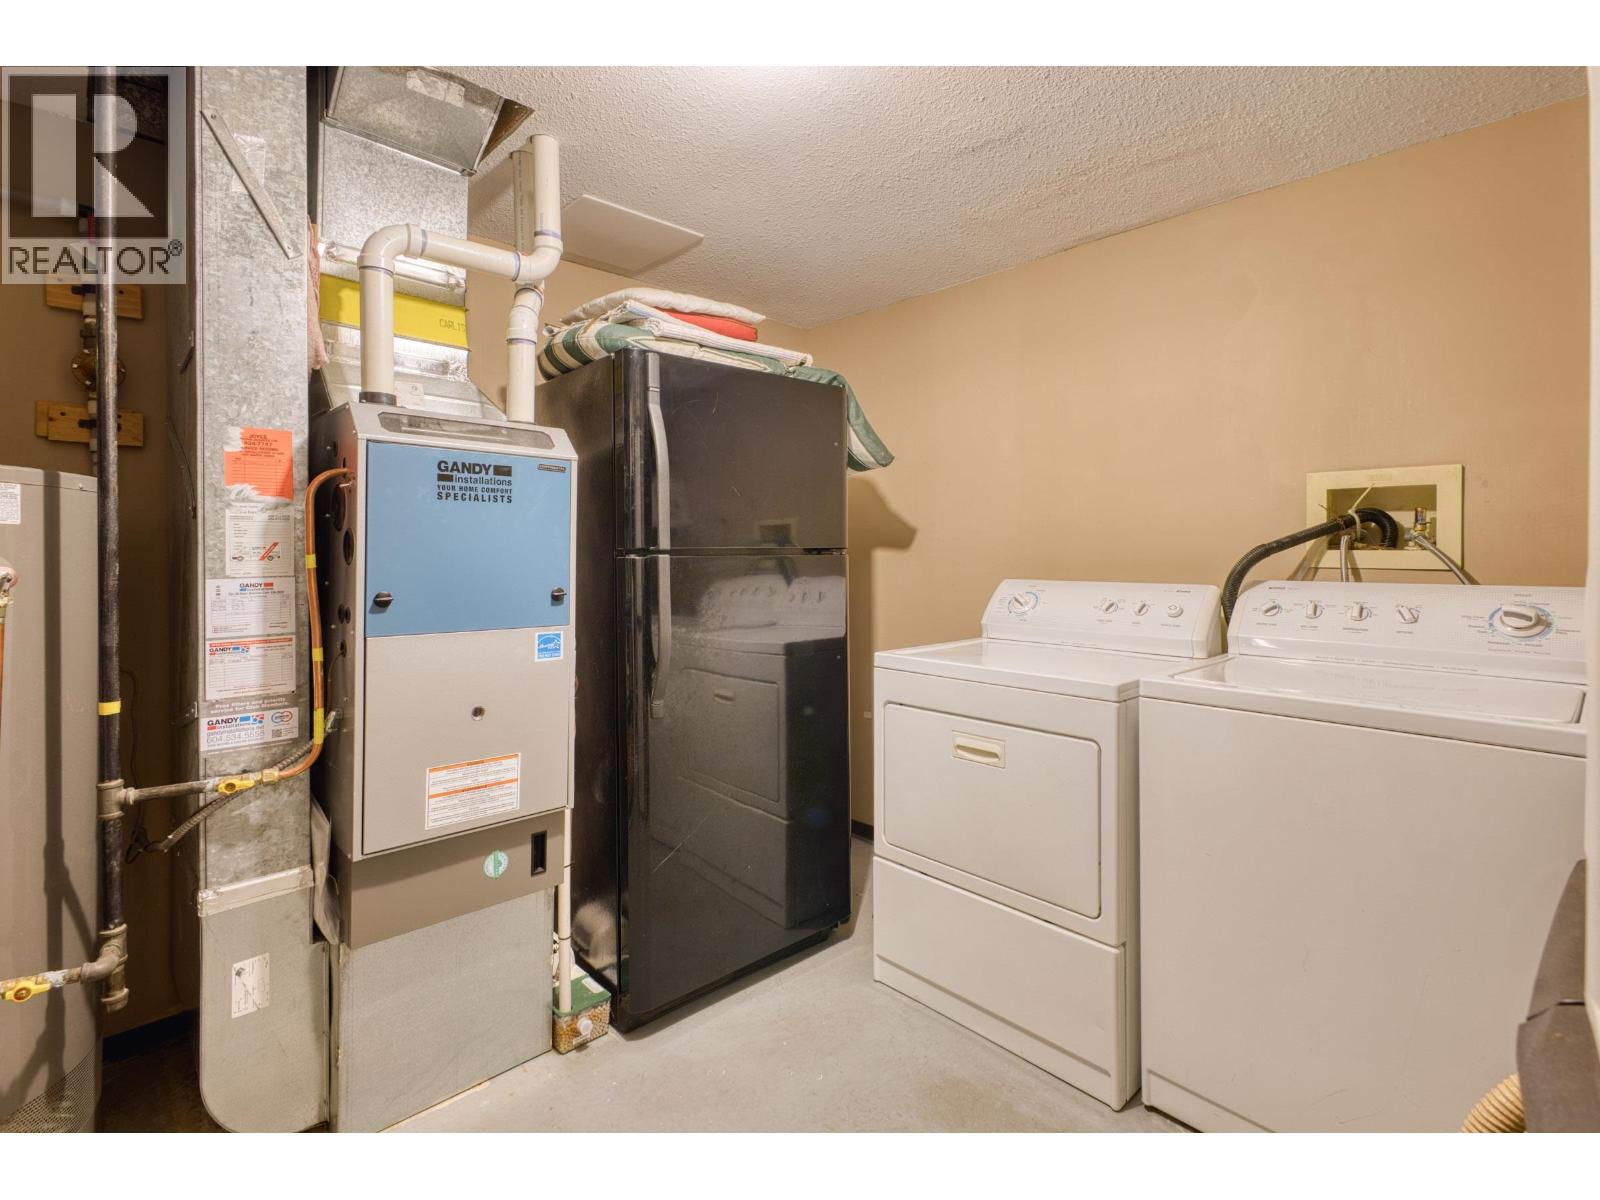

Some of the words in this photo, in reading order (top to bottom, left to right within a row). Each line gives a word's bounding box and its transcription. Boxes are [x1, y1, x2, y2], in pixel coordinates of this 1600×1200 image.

[437, 460, 492, 475] GANDY
[454, 475, 512, 486] installations
[437, 492, 512, 504] SPECIALISTS
[207, 717, 239, 726] GANDY
